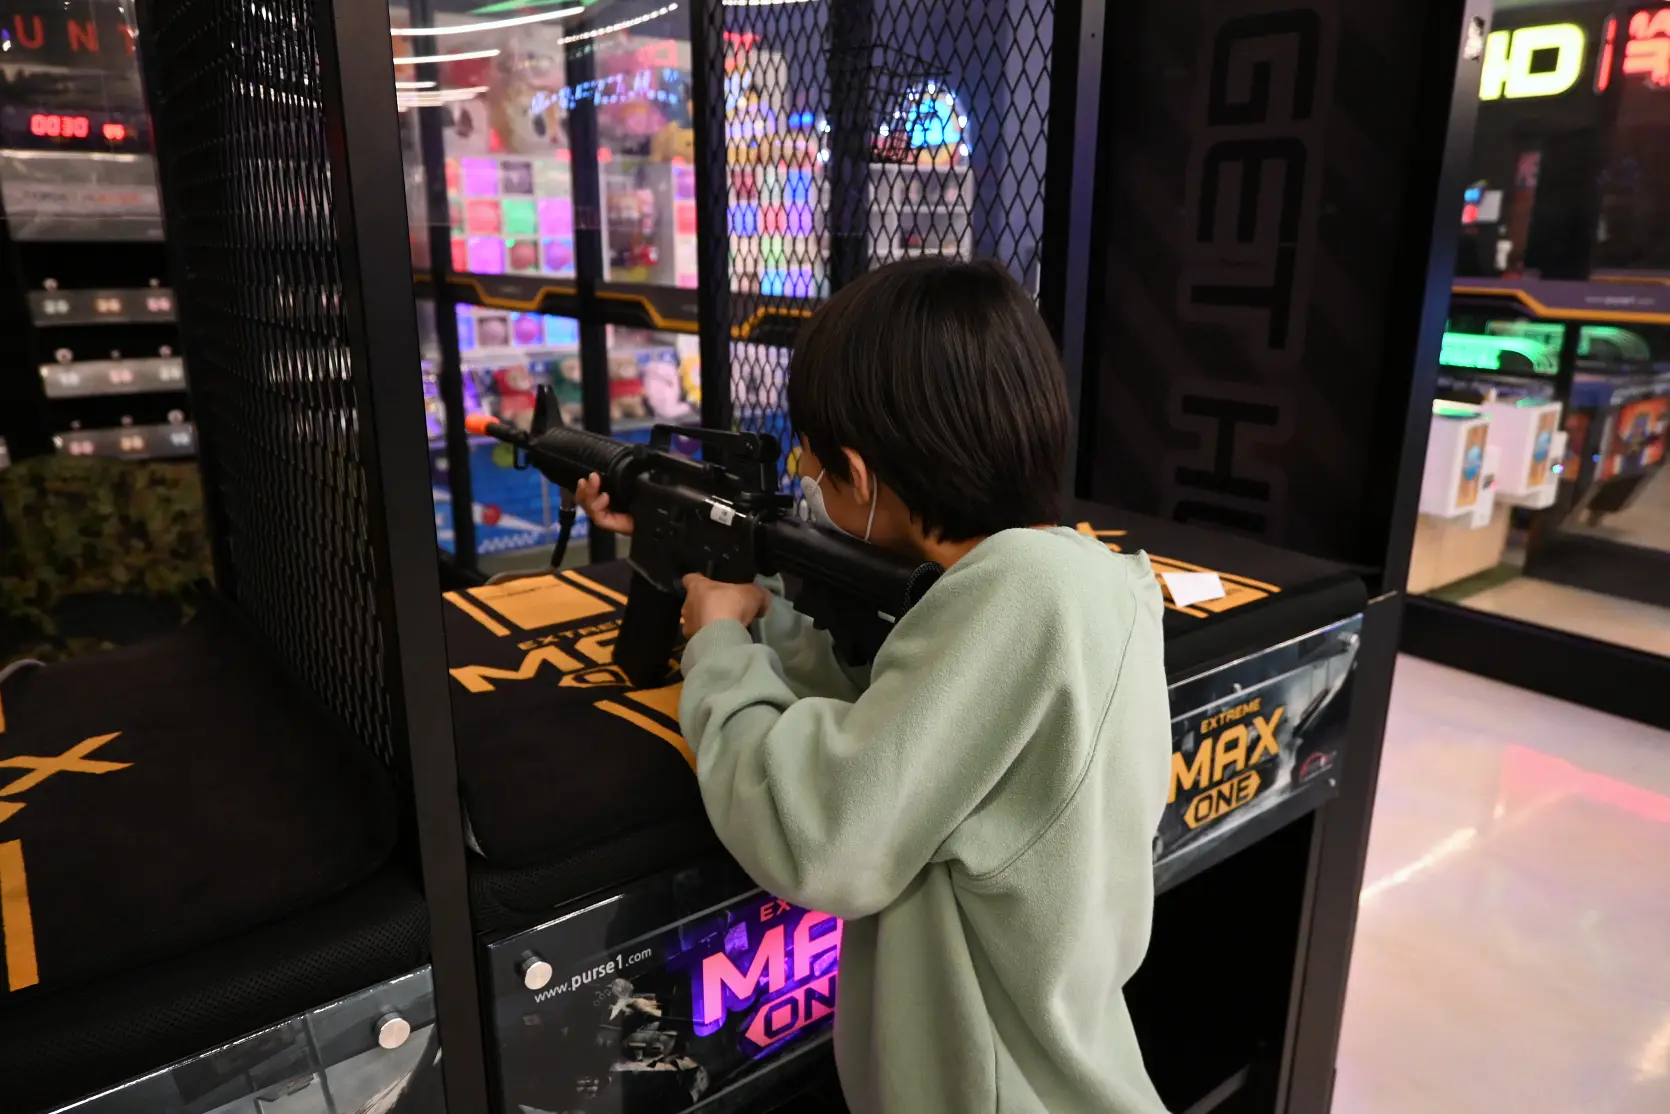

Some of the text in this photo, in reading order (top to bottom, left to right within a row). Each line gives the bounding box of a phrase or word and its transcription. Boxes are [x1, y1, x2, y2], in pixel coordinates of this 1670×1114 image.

[1190, 8, 1322, 350] GET
[448, 628, 680, 693] MA
[1199, 697, 1263, 734] EXTREME
[1167, 705, 1286, 804] MAX
[1193, 774, 1254, 823] ONE
[760, 901, 792, 923] EX
[533, 946, 653, 1005] www.purse1.com
[702, 911, 844, 1026] MA
[763, 975, 836, 1040] ON
